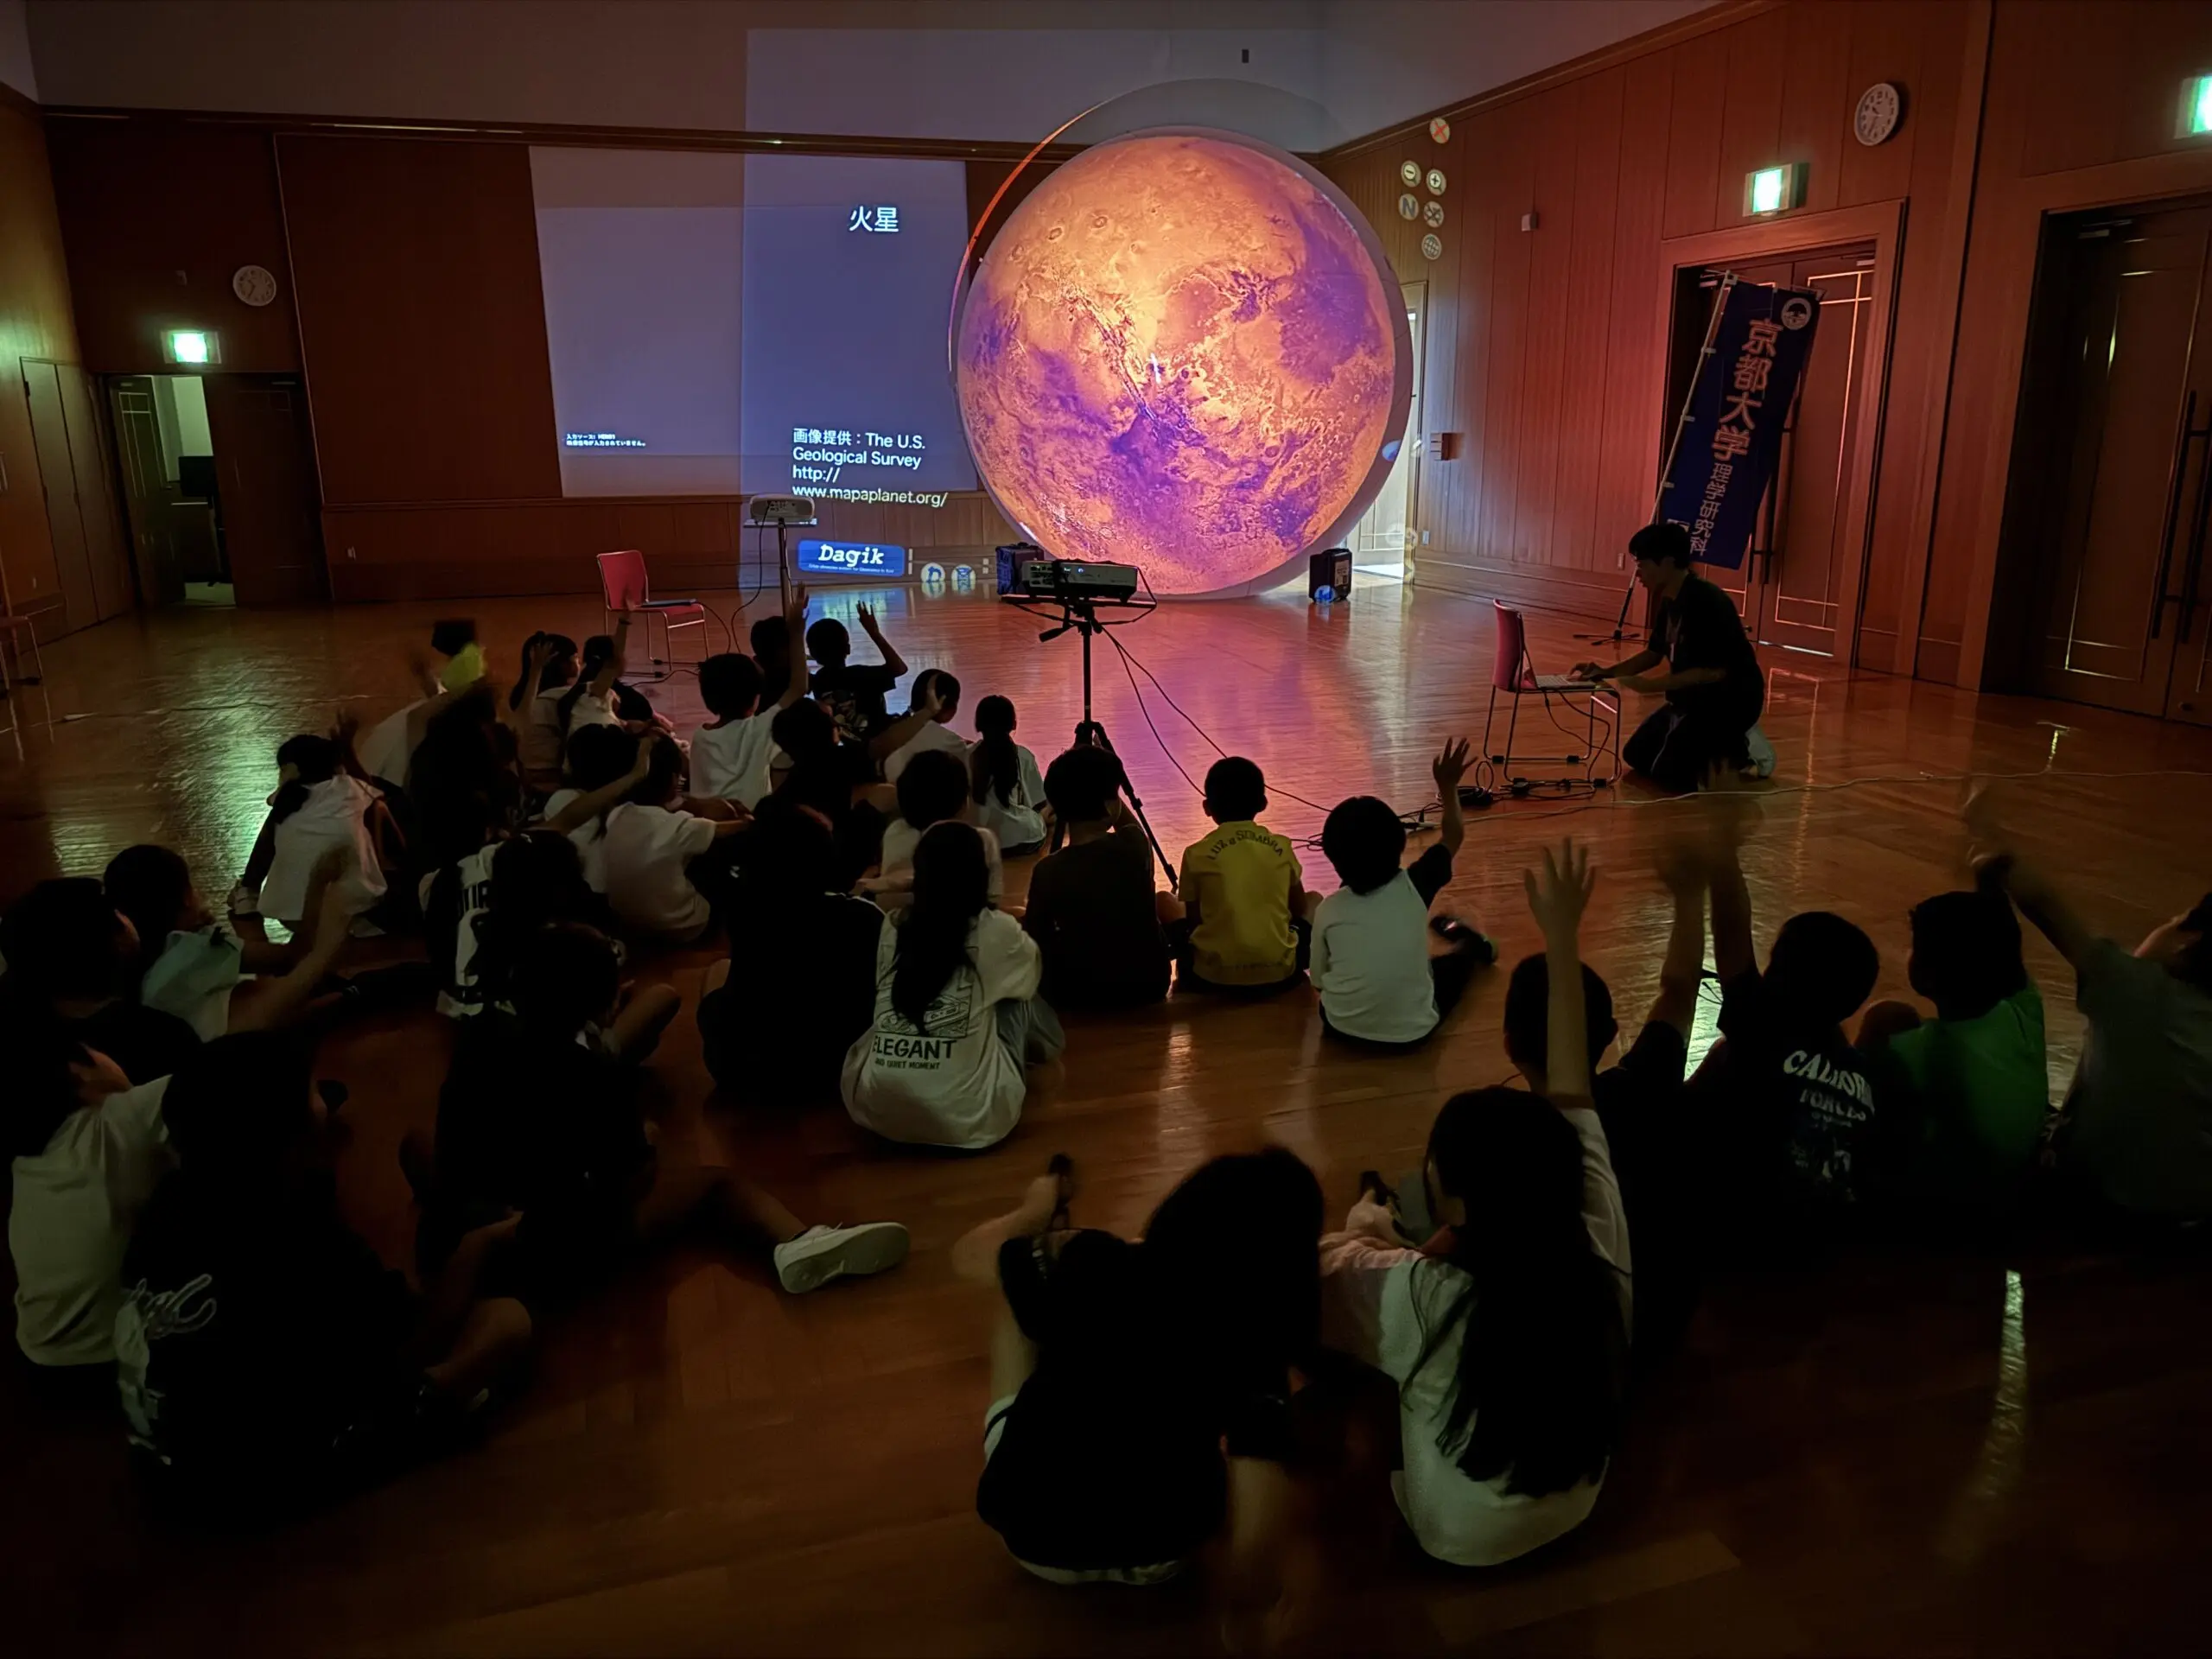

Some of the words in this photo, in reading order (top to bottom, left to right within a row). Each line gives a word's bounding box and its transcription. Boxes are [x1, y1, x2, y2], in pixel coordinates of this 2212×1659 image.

[849, 206, 899, 232] 火星
[1712, 318, 1783, 461] 京都大学
[865, 432, 893, 448] The
[897, 434, 926, 449] U.S.
[792, 446, 868, 465] Geological
[871, 451, 922, 470] Survey
[792, 464, 841, 484] http://
[792, 486, 949, 508] www.mapaplanet.org/
[1690, 462, 1733, 556] 理学研究科
[817, 543, 886, 567] Dagik
[909, 1061, 940, 1070] MOMENT
